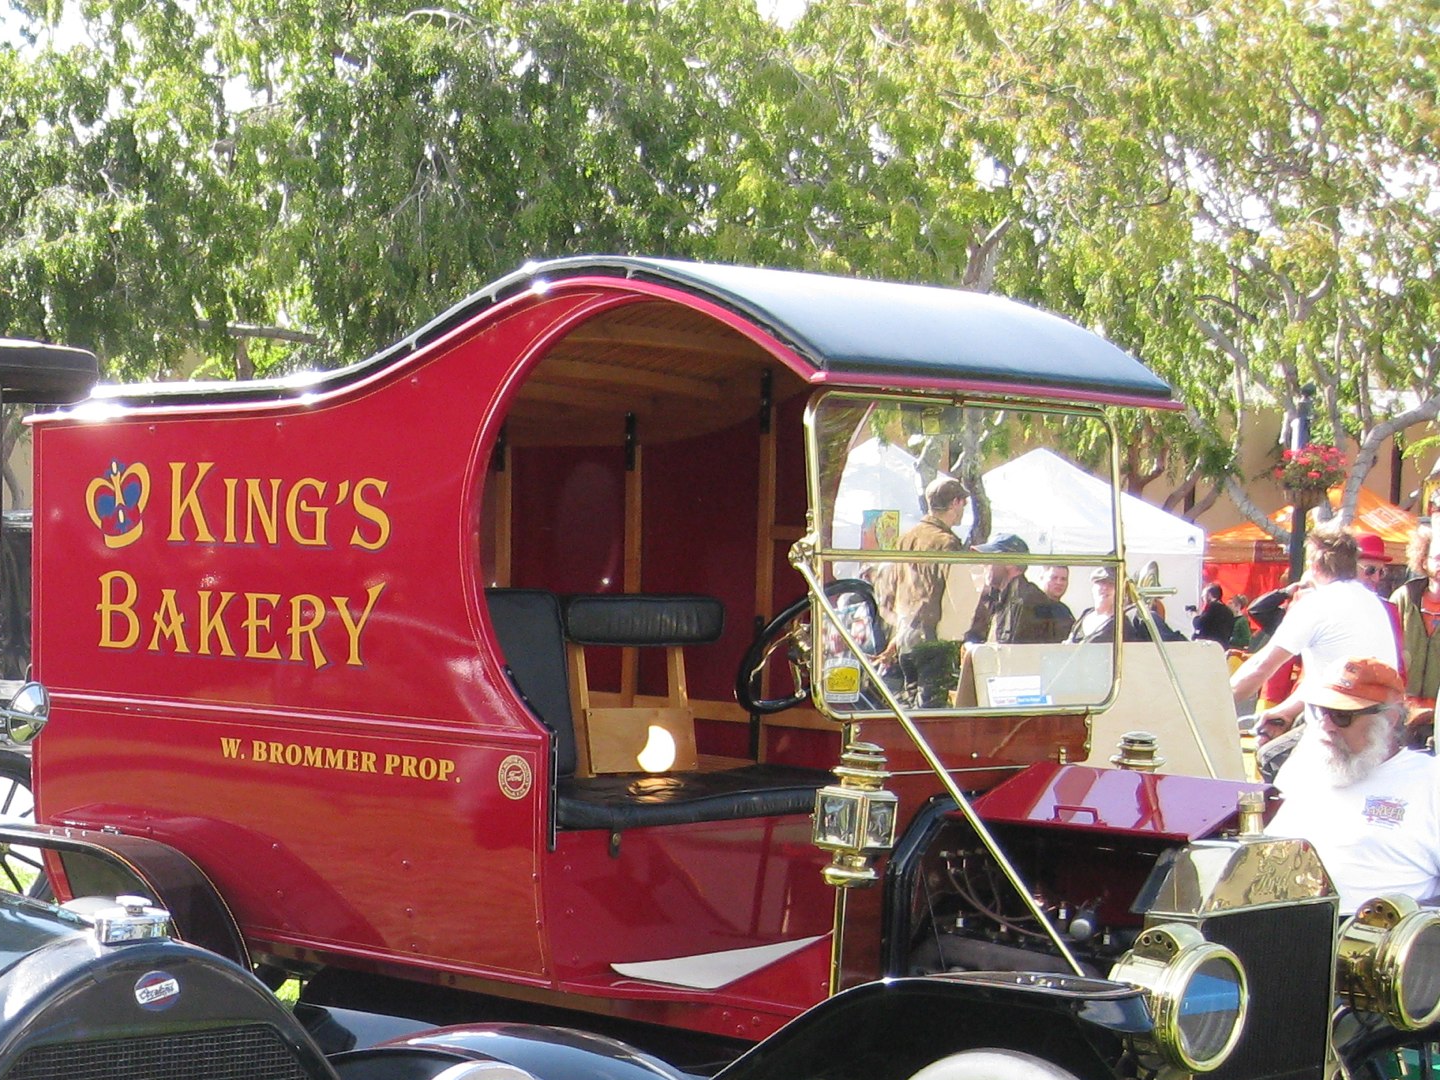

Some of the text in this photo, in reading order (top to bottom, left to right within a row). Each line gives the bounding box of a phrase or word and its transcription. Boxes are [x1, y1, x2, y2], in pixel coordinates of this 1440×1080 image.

[167, 461, 392, 551] KING'S
[96, 569, 387, 671] BAKERY
[220, 737, 461, 784] W. BROMMER PROP.
